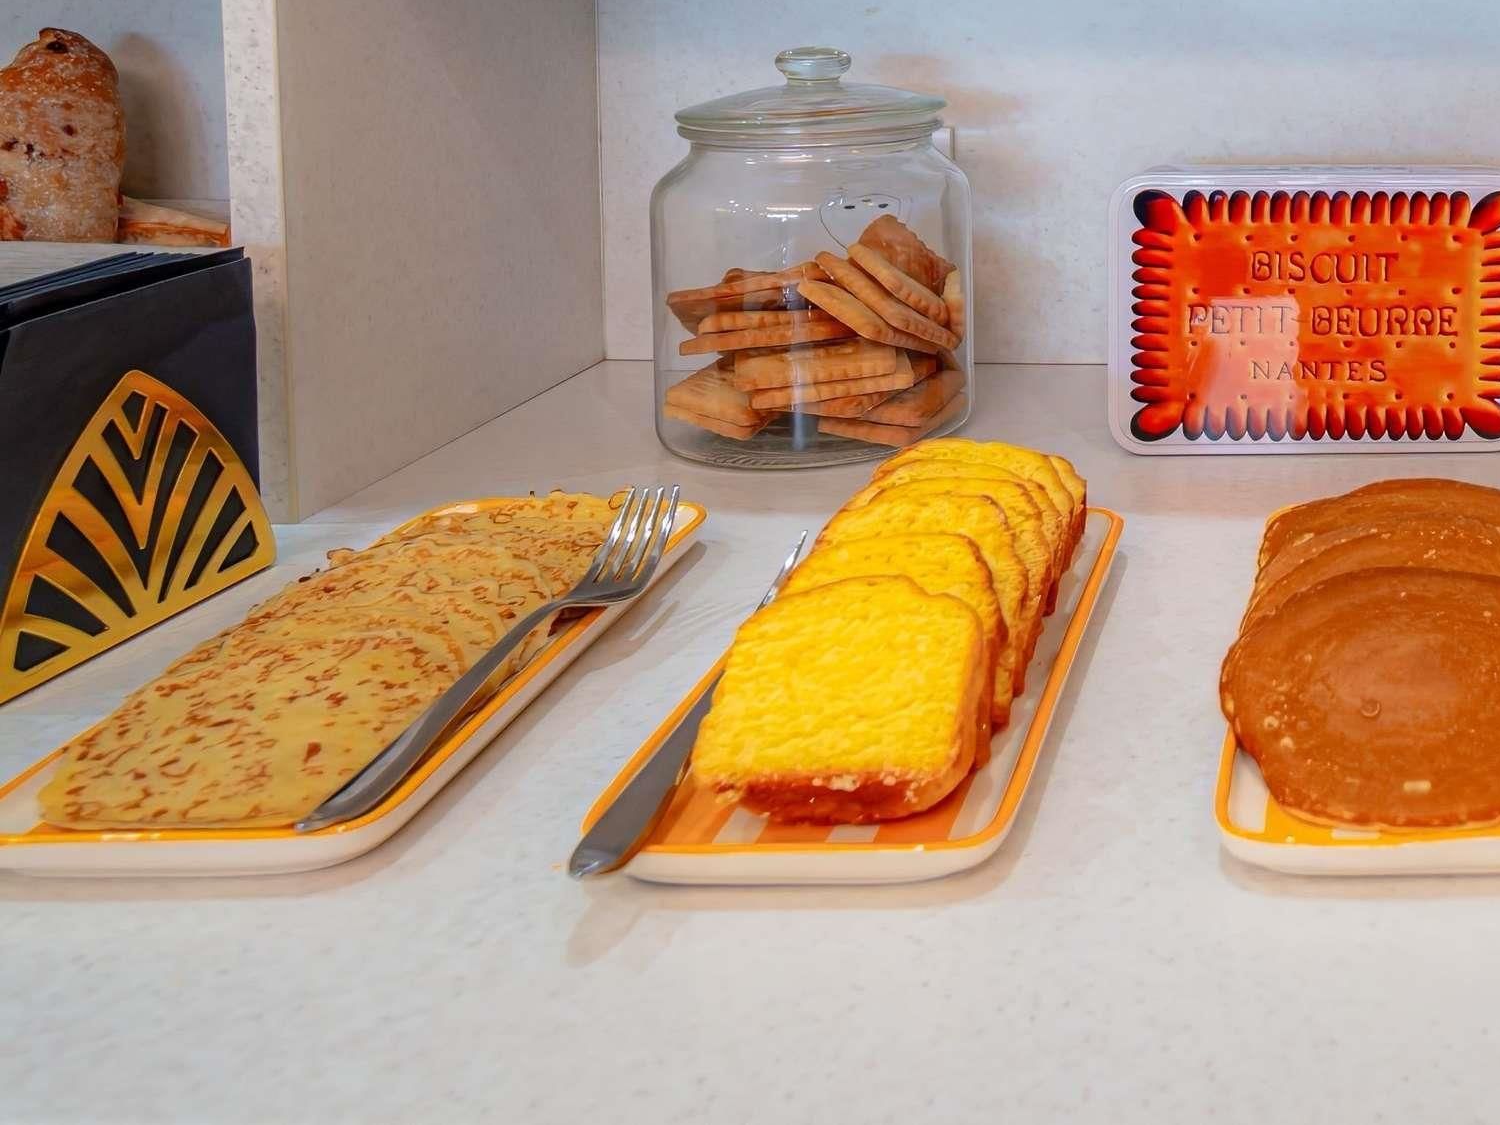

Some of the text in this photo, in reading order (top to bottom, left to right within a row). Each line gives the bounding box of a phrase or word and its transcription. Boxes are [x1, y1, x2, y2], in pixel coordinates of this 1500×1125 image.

[1250, 250, 1399, 283] BISCUIT
[1311, 305, 1458, 337] BEURRE
[1251, 359, 1388, 382] NANTES
